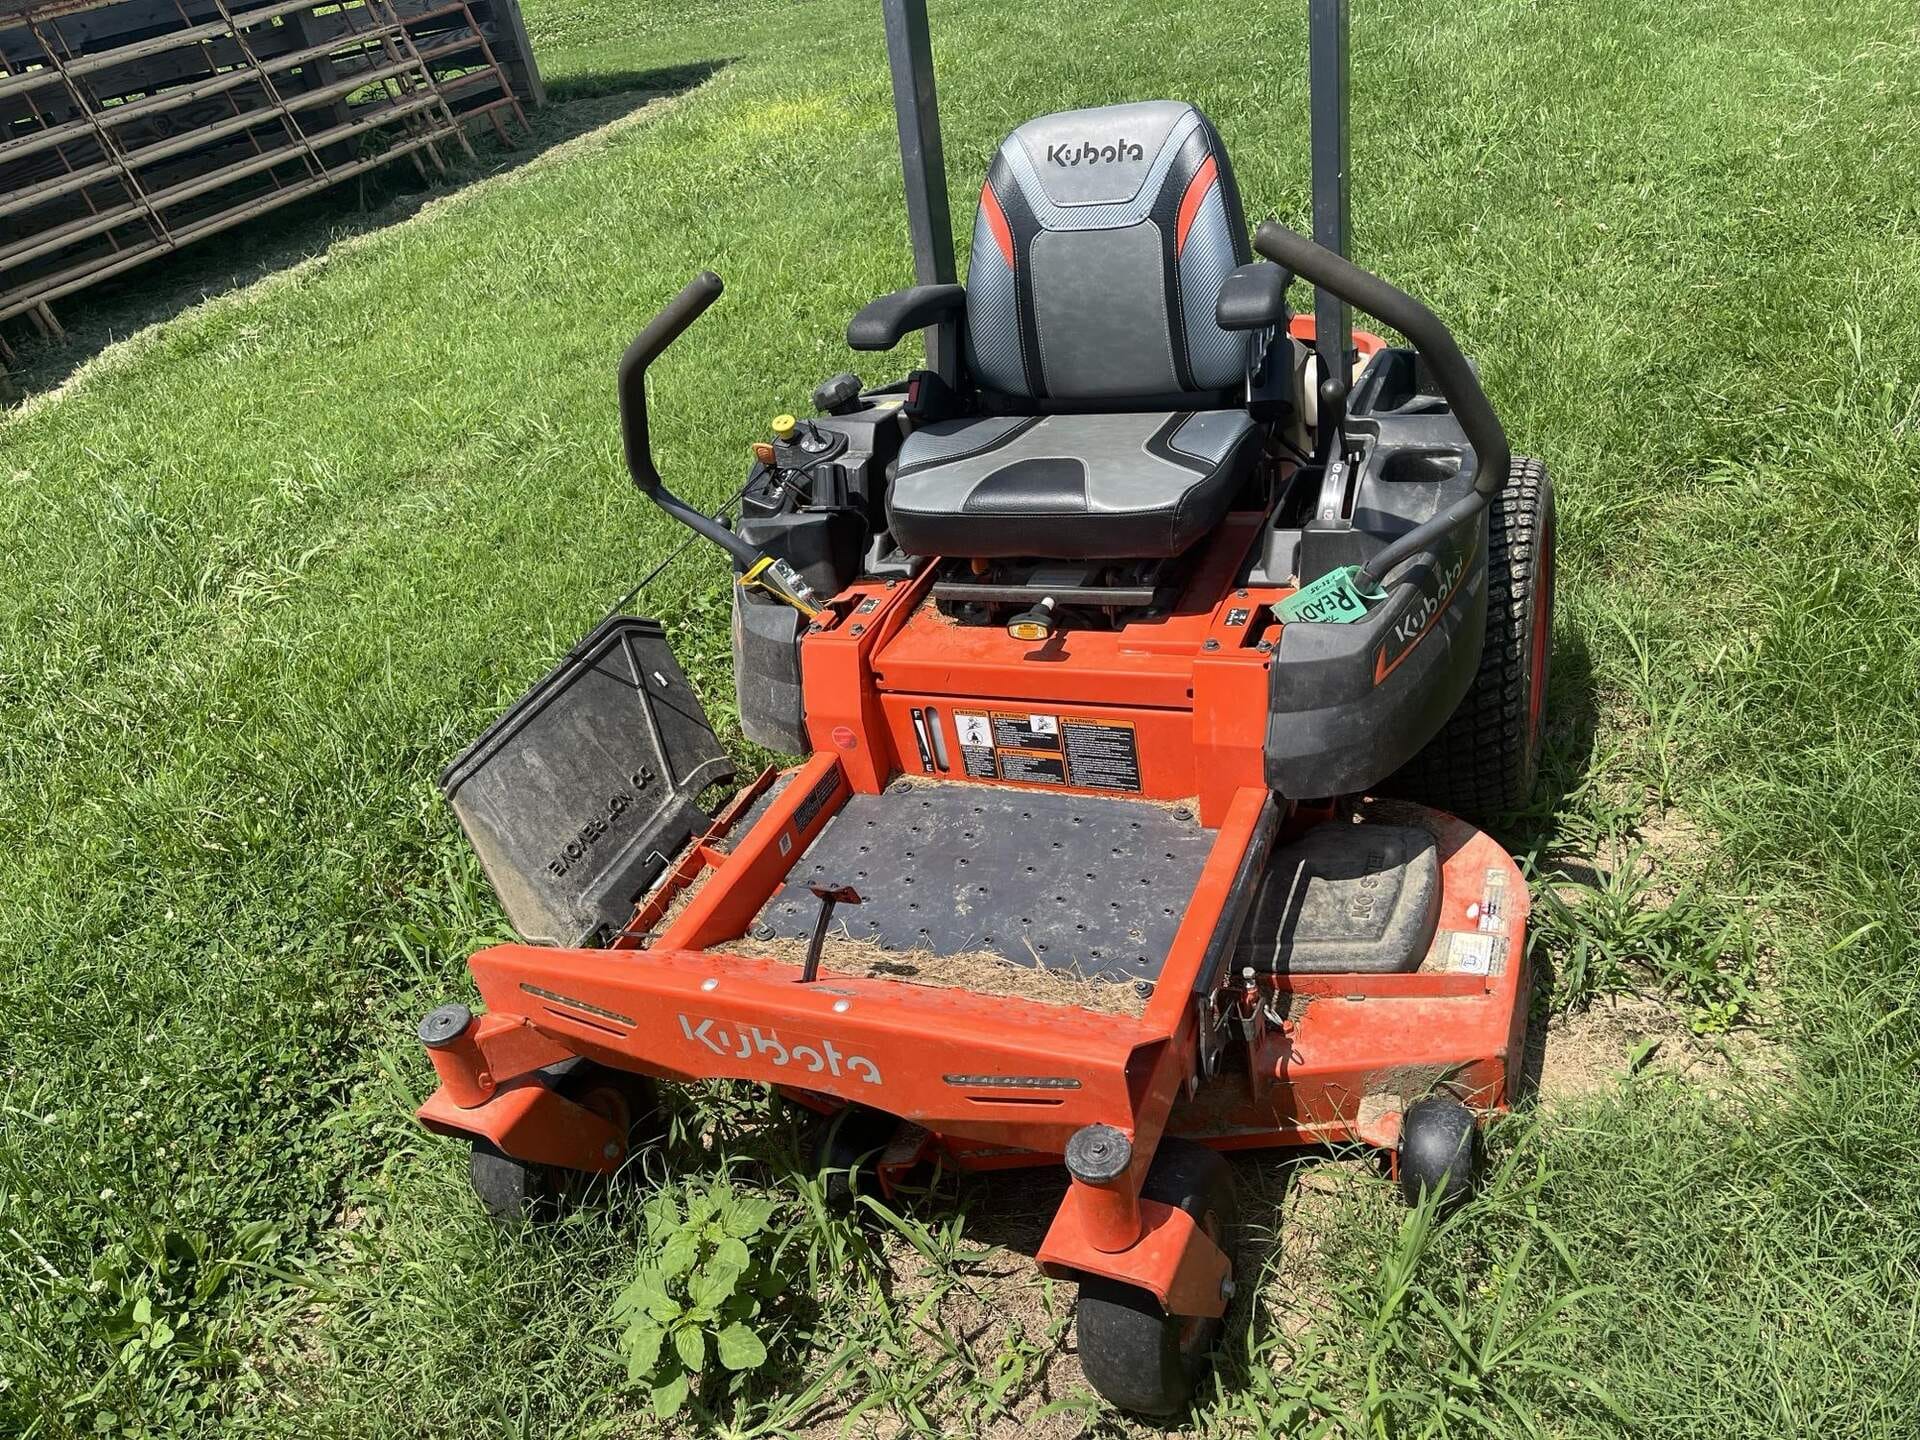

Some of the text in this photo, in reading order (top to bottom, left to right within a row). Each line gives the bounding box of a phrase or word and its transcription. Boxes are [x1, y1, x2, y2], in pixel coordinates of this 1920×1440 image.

[1047, 138, 1144, 168] Kubota
[1295, 585, 1357, 623] READY
[1394, 554, 1464, 642] Kubota
[925, 763, 934, 772] E
[547, 764, 655, 877] DO NOT REMOVE
[1351, 893, 1377, 921] NO
[678, 1013, 882, 1085] Kubota
